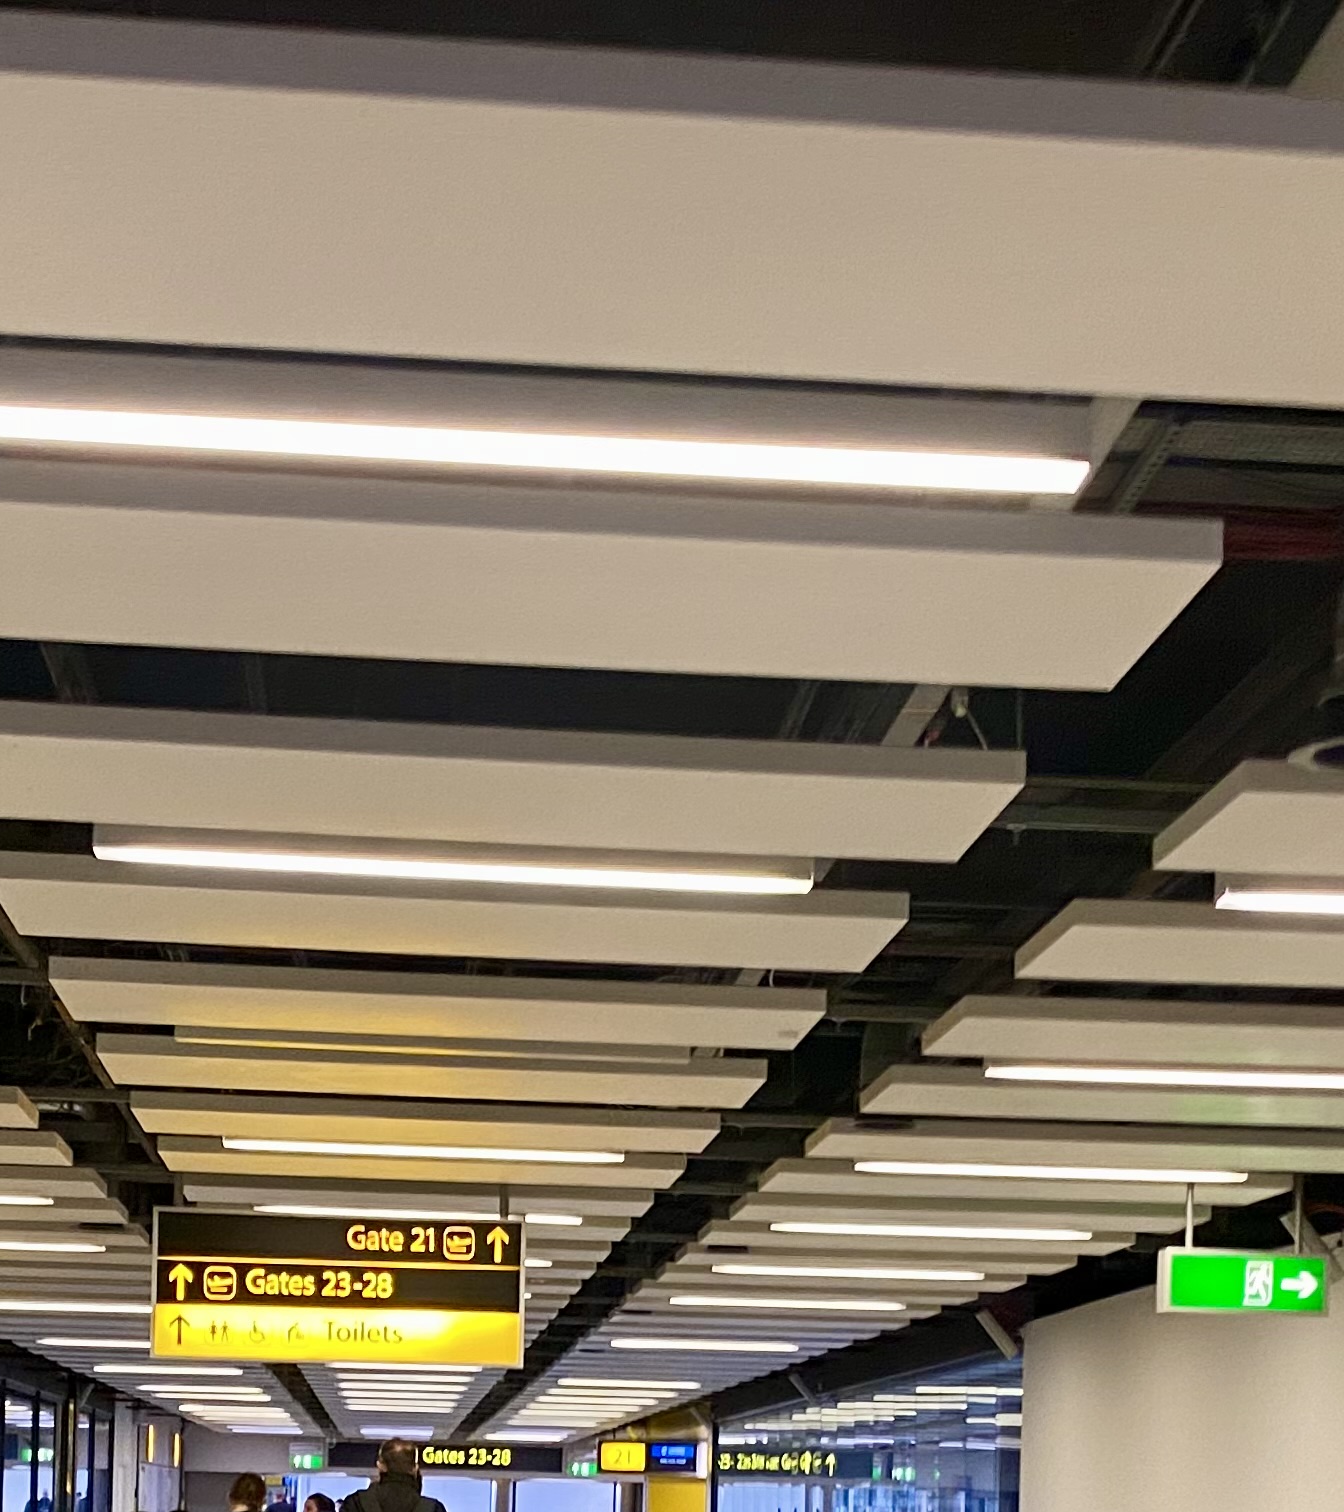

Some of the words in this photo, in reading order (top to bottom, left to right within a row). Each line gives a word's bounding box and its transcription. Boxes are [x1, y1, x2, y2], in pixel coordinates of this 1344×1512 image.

[346, 1224, 404, 1252] Gate
[410, 1227, 435, 1252] 21
[245, 1268, 316, 1297] Gates
[321, 1270, 393, 1299] 23-28
[324, 1321, 403, 1344] Toilets
[422, 1446, 465, 1464] Gates
[614, 1449, 631, 1464] 21
